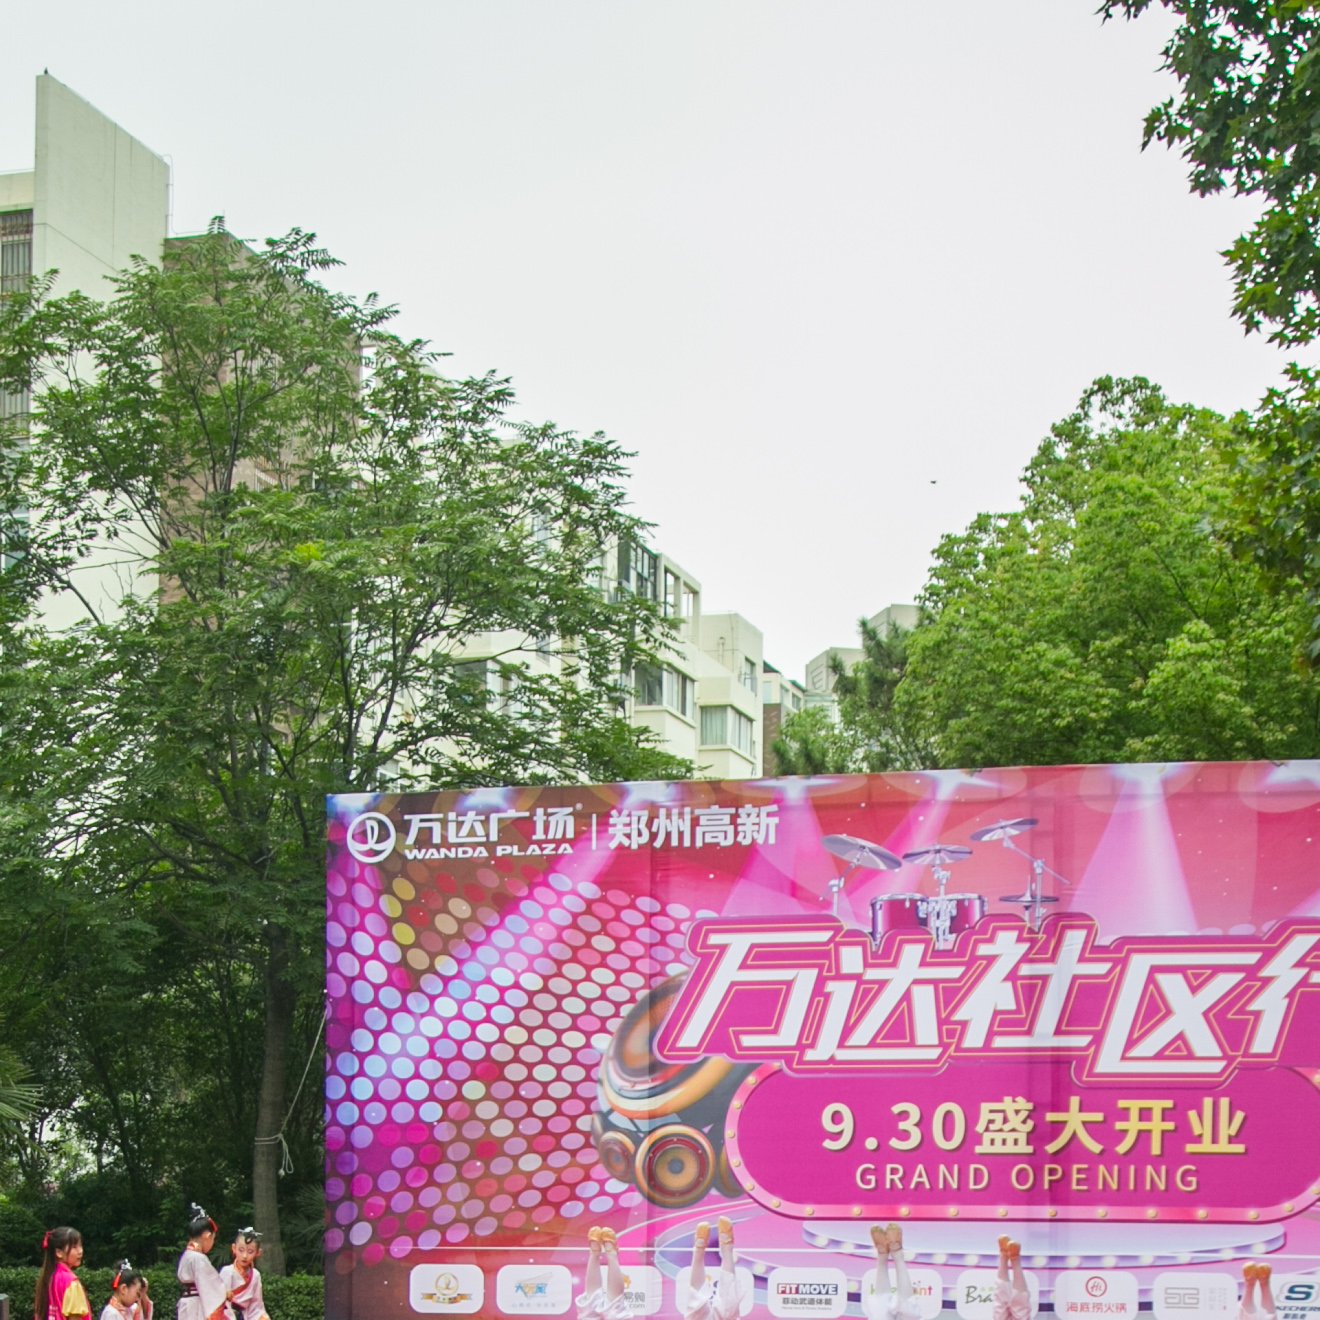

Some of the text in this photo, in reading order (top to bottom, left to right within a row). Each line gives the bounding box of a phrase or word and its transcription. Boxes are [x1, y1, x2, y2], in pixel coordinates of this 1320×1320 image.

[403, 803, 779, 850] 万达广场 郑州高新
[404, 842, 574, 860] WANDA PLAZA
[821, 1096, 1246, 1156] 9.30盛大开业
[855, 1163, 1198, 1191] GRAND OPENING
[965, 1285, 994, 1304] Bra
[1066, 1301, 1127, 1313] 海底捞火锅
